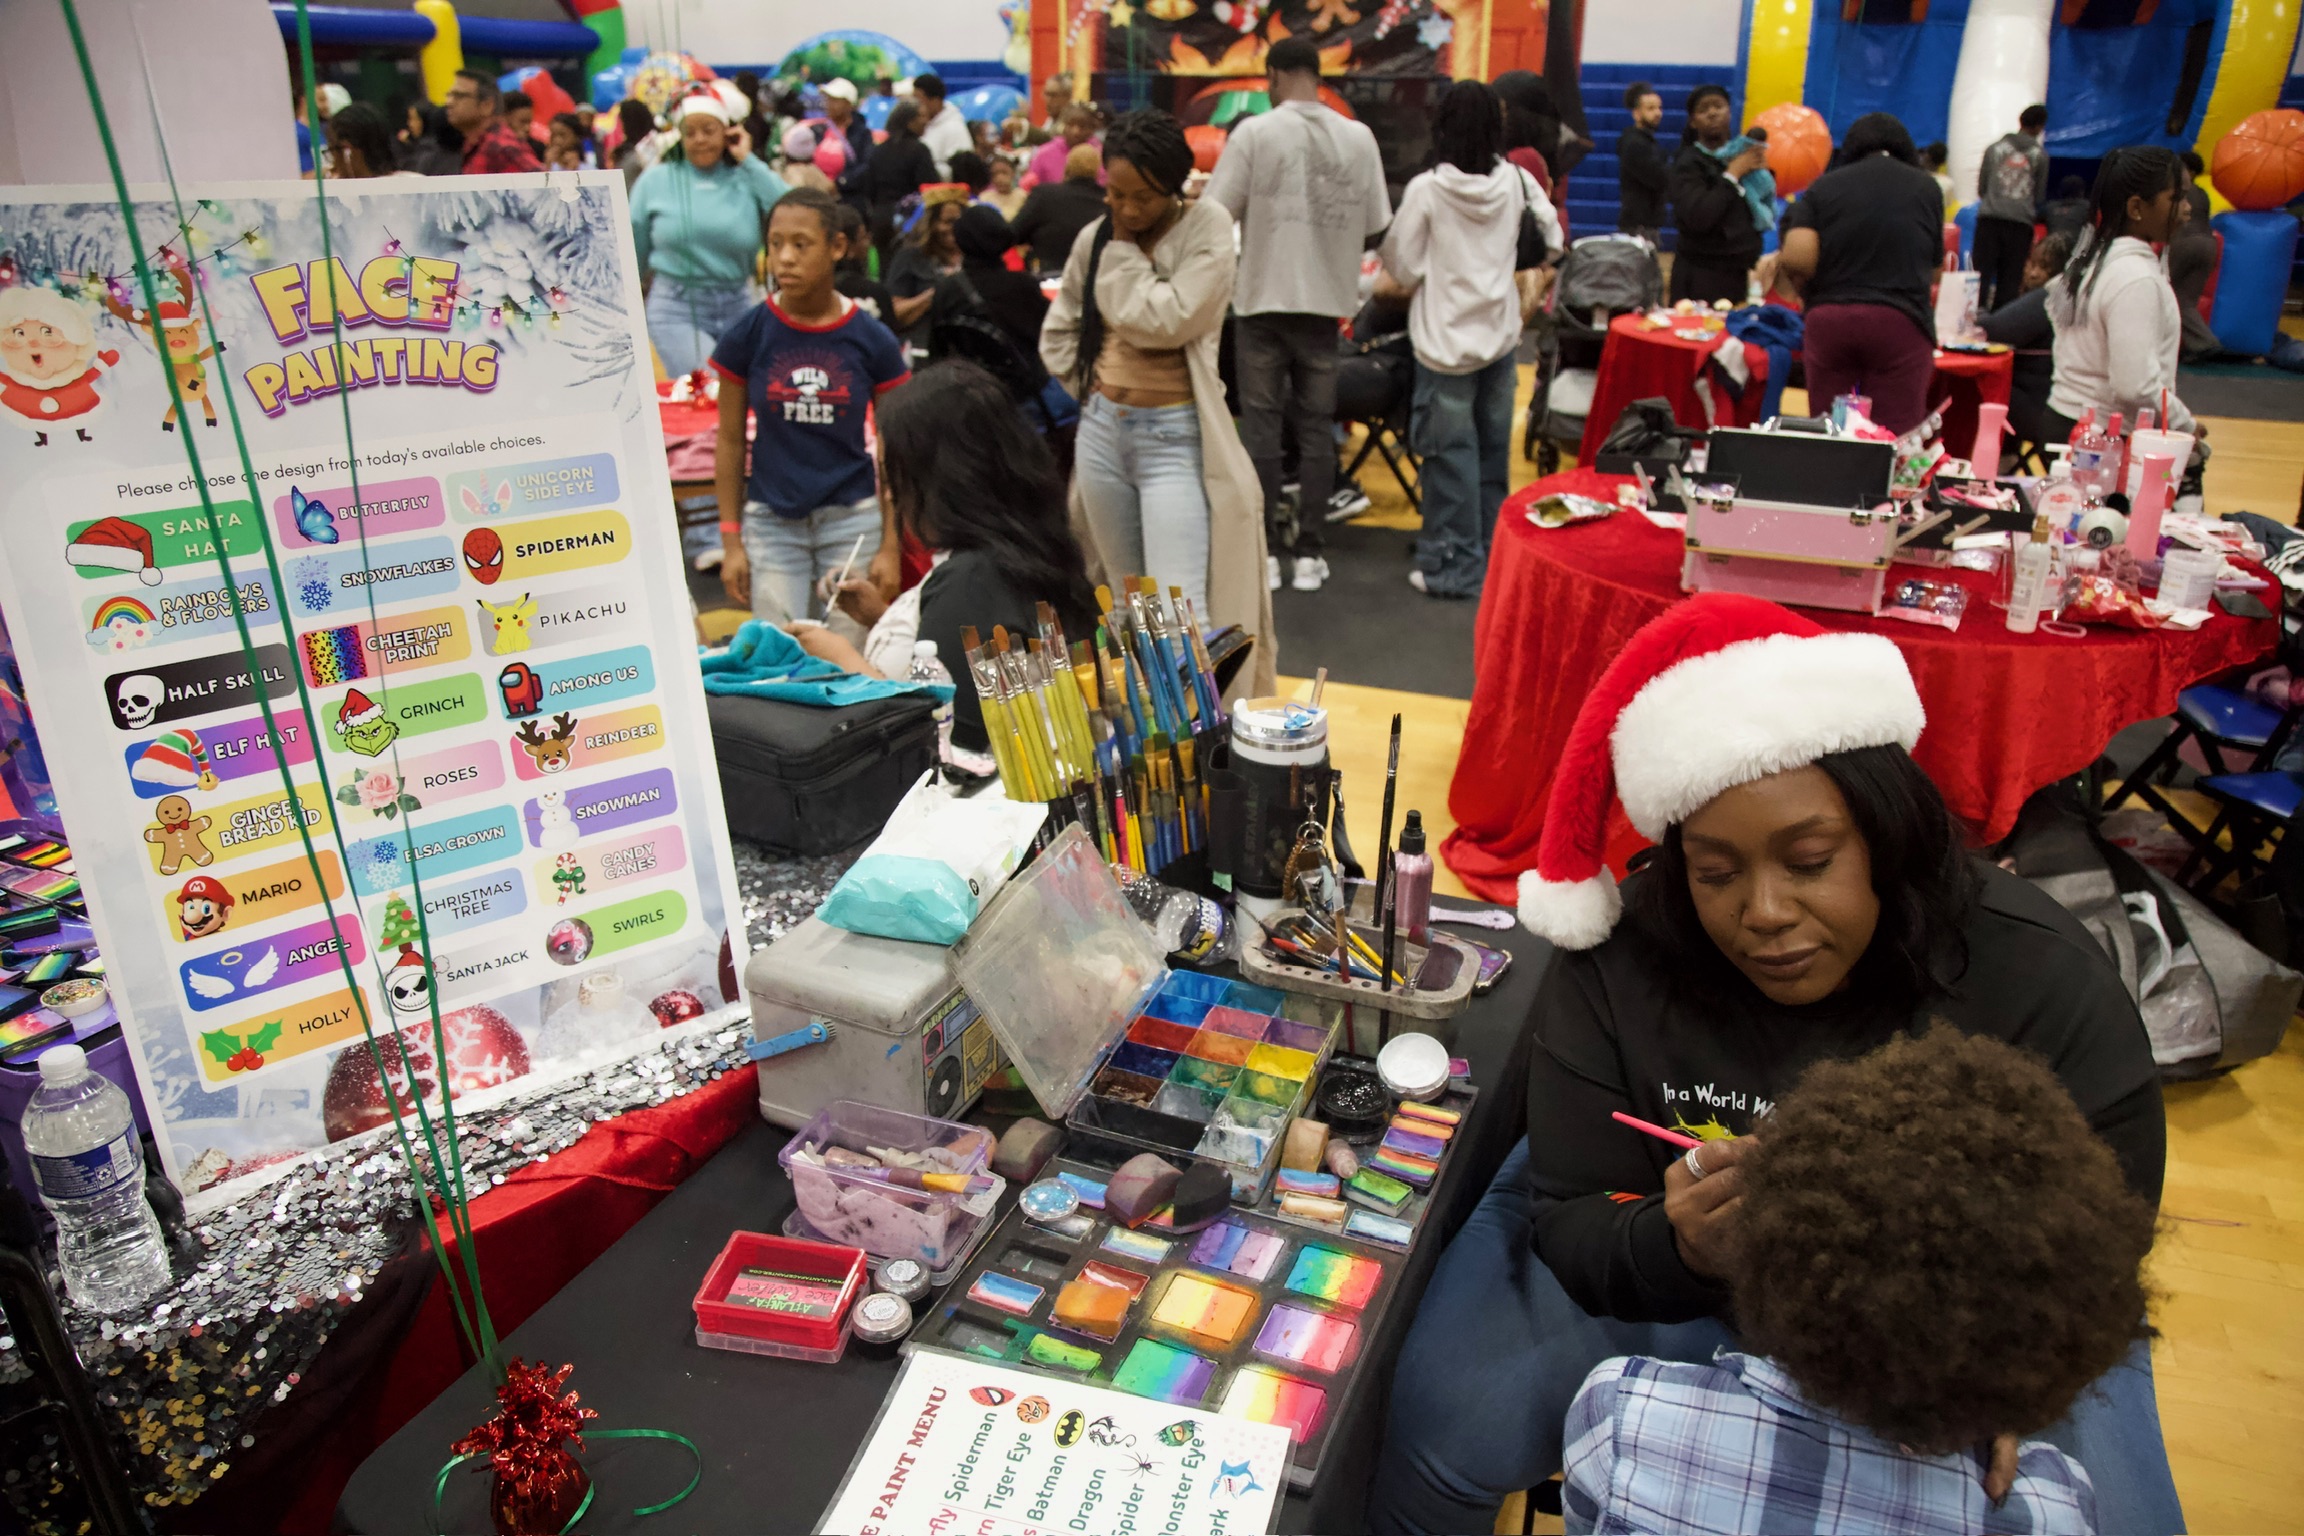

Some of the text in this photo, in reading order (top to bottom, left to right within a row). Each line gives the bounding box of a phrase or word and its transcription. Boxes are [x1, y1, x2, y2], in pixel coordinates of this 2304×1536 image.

[250, 256, 461, 346] FACE
[244, 337, 499, 419] PAINTING
[783, 402, 834, 424] FREE
[117, 481, 173, 498] Please
[241, 471, 269, 483] one
[275, 463, 324, 478] design
[328, 457, 362, 471] from
[367, 447, 418, 467] today's
[422, 440, 486, 459] available
[490, 433, 546, 450] choices.
[516, 466, 594, 488] UNICORN
[524, 481, 595, 502] SIDE EYE
[338, 495, 430, 520] BUTTERFLY
[162, 512, 243, 537] SANTA
[184, 538, 230, 558] HAT
[515, 530, 615, 558] SPIDERMAN
[341, 557, 455, 588] SNOWFLAKES
[160, 582, 264, 613] RAINBOWS
[162, 597, 270, 628] & FLOWERS
[540, 602, 627, 628] PIKACHU
[366, 623, 452, 651] CHEETAH
[386, 640, 439, 664] PRINT
[168, 679, 218, 703] HALF
[549, 666, 639, 696] AMONG US
[400, 695, 465, 720] GRINCH
[213, 738, 249, 760] ELF
[585, 723, 657, 750] REINDEER
[423, 766, 478, 789] ROSES
[575, 788, 661, 820] SNOWMAN
[219, 809, 322, 848] BREAD KID
[403, 826, 506, 864] ELSA CROWN
[600, 842, 655, 868] CANDY
[604, 855, 657, 881] CANES
[242, 879, 302, 905] MARIO
[424, 881, 513, 915] CHRISTMAS
[451, 899, 491, 920] TREE
[612, 909, 665, 934] SWIRLS
[287, 936, 351, 966] ANGEL
[447, 949, 530, 983] SANTA JACK
[298, 1007, 350, 1034] HOLLY
[1662, 1082, 1676, 1104] In
[1679, 1090, 1690, 1101] a
[1694, 1083, 1747, 1110] World
[869, 1452, 916, 1521] PAINT
[906, 1386, 948, 1448] MENU
[944, 1411, 998, 1502] Spiderman
[984, 1465, 1017, 1510] Tiger
[1006, 1432, 1032, 1463] Eye
[1027, 1454, 1067, 1521] Batman
[1068, 1468, 1107, 1532] Dragon
[1158, 1437, 1206, 1536] onster Eye
